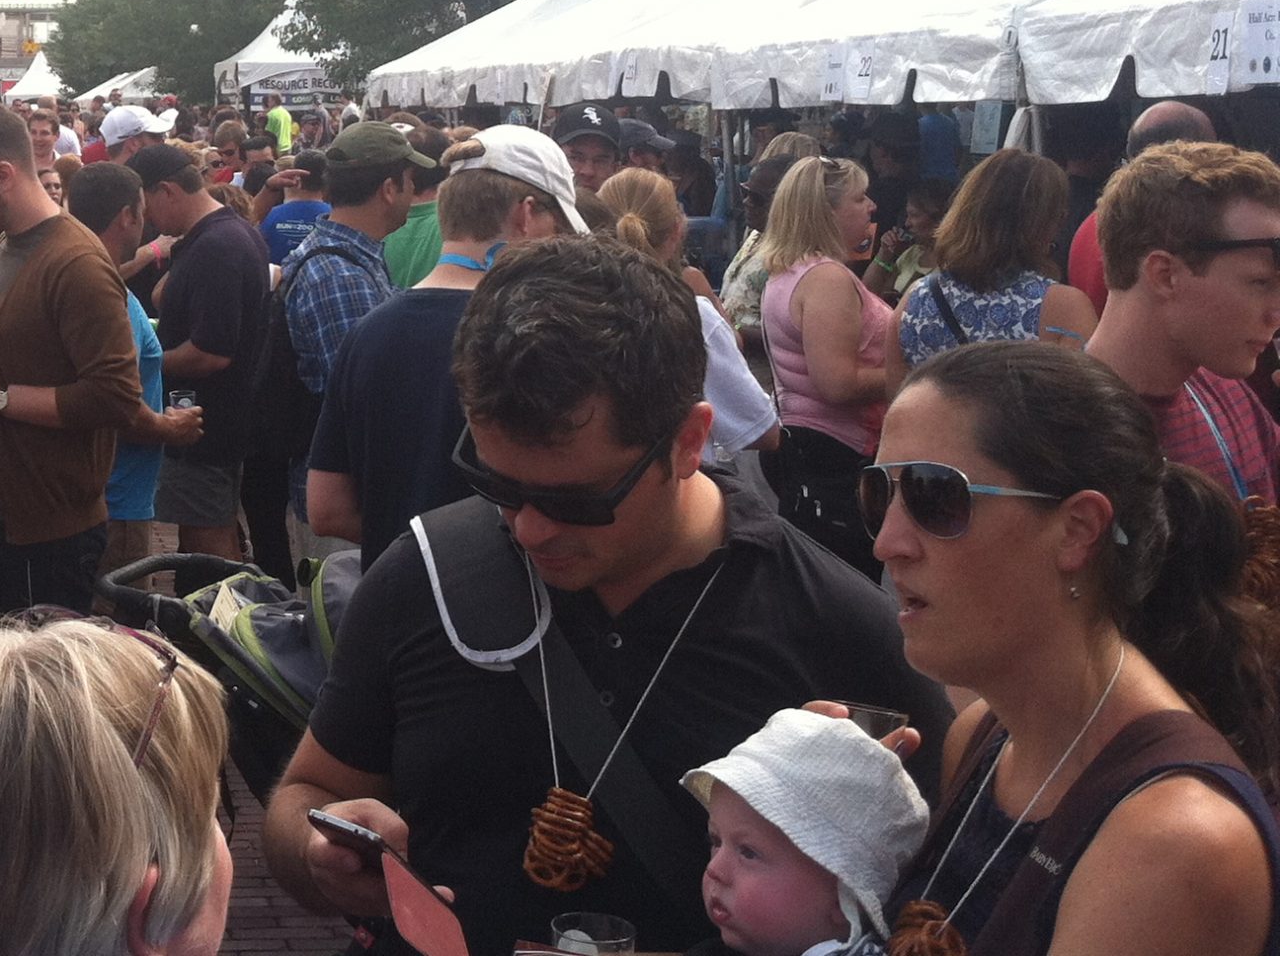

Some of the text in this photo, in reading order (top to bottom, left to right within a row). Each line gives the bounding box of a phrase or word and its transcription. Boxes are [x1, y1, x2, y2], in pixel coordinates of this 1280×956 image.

[1210, 28, 1229, 61] 21
[858, 56, 873, 77] 22
[260, 79, 308, 91] RESOURCE
